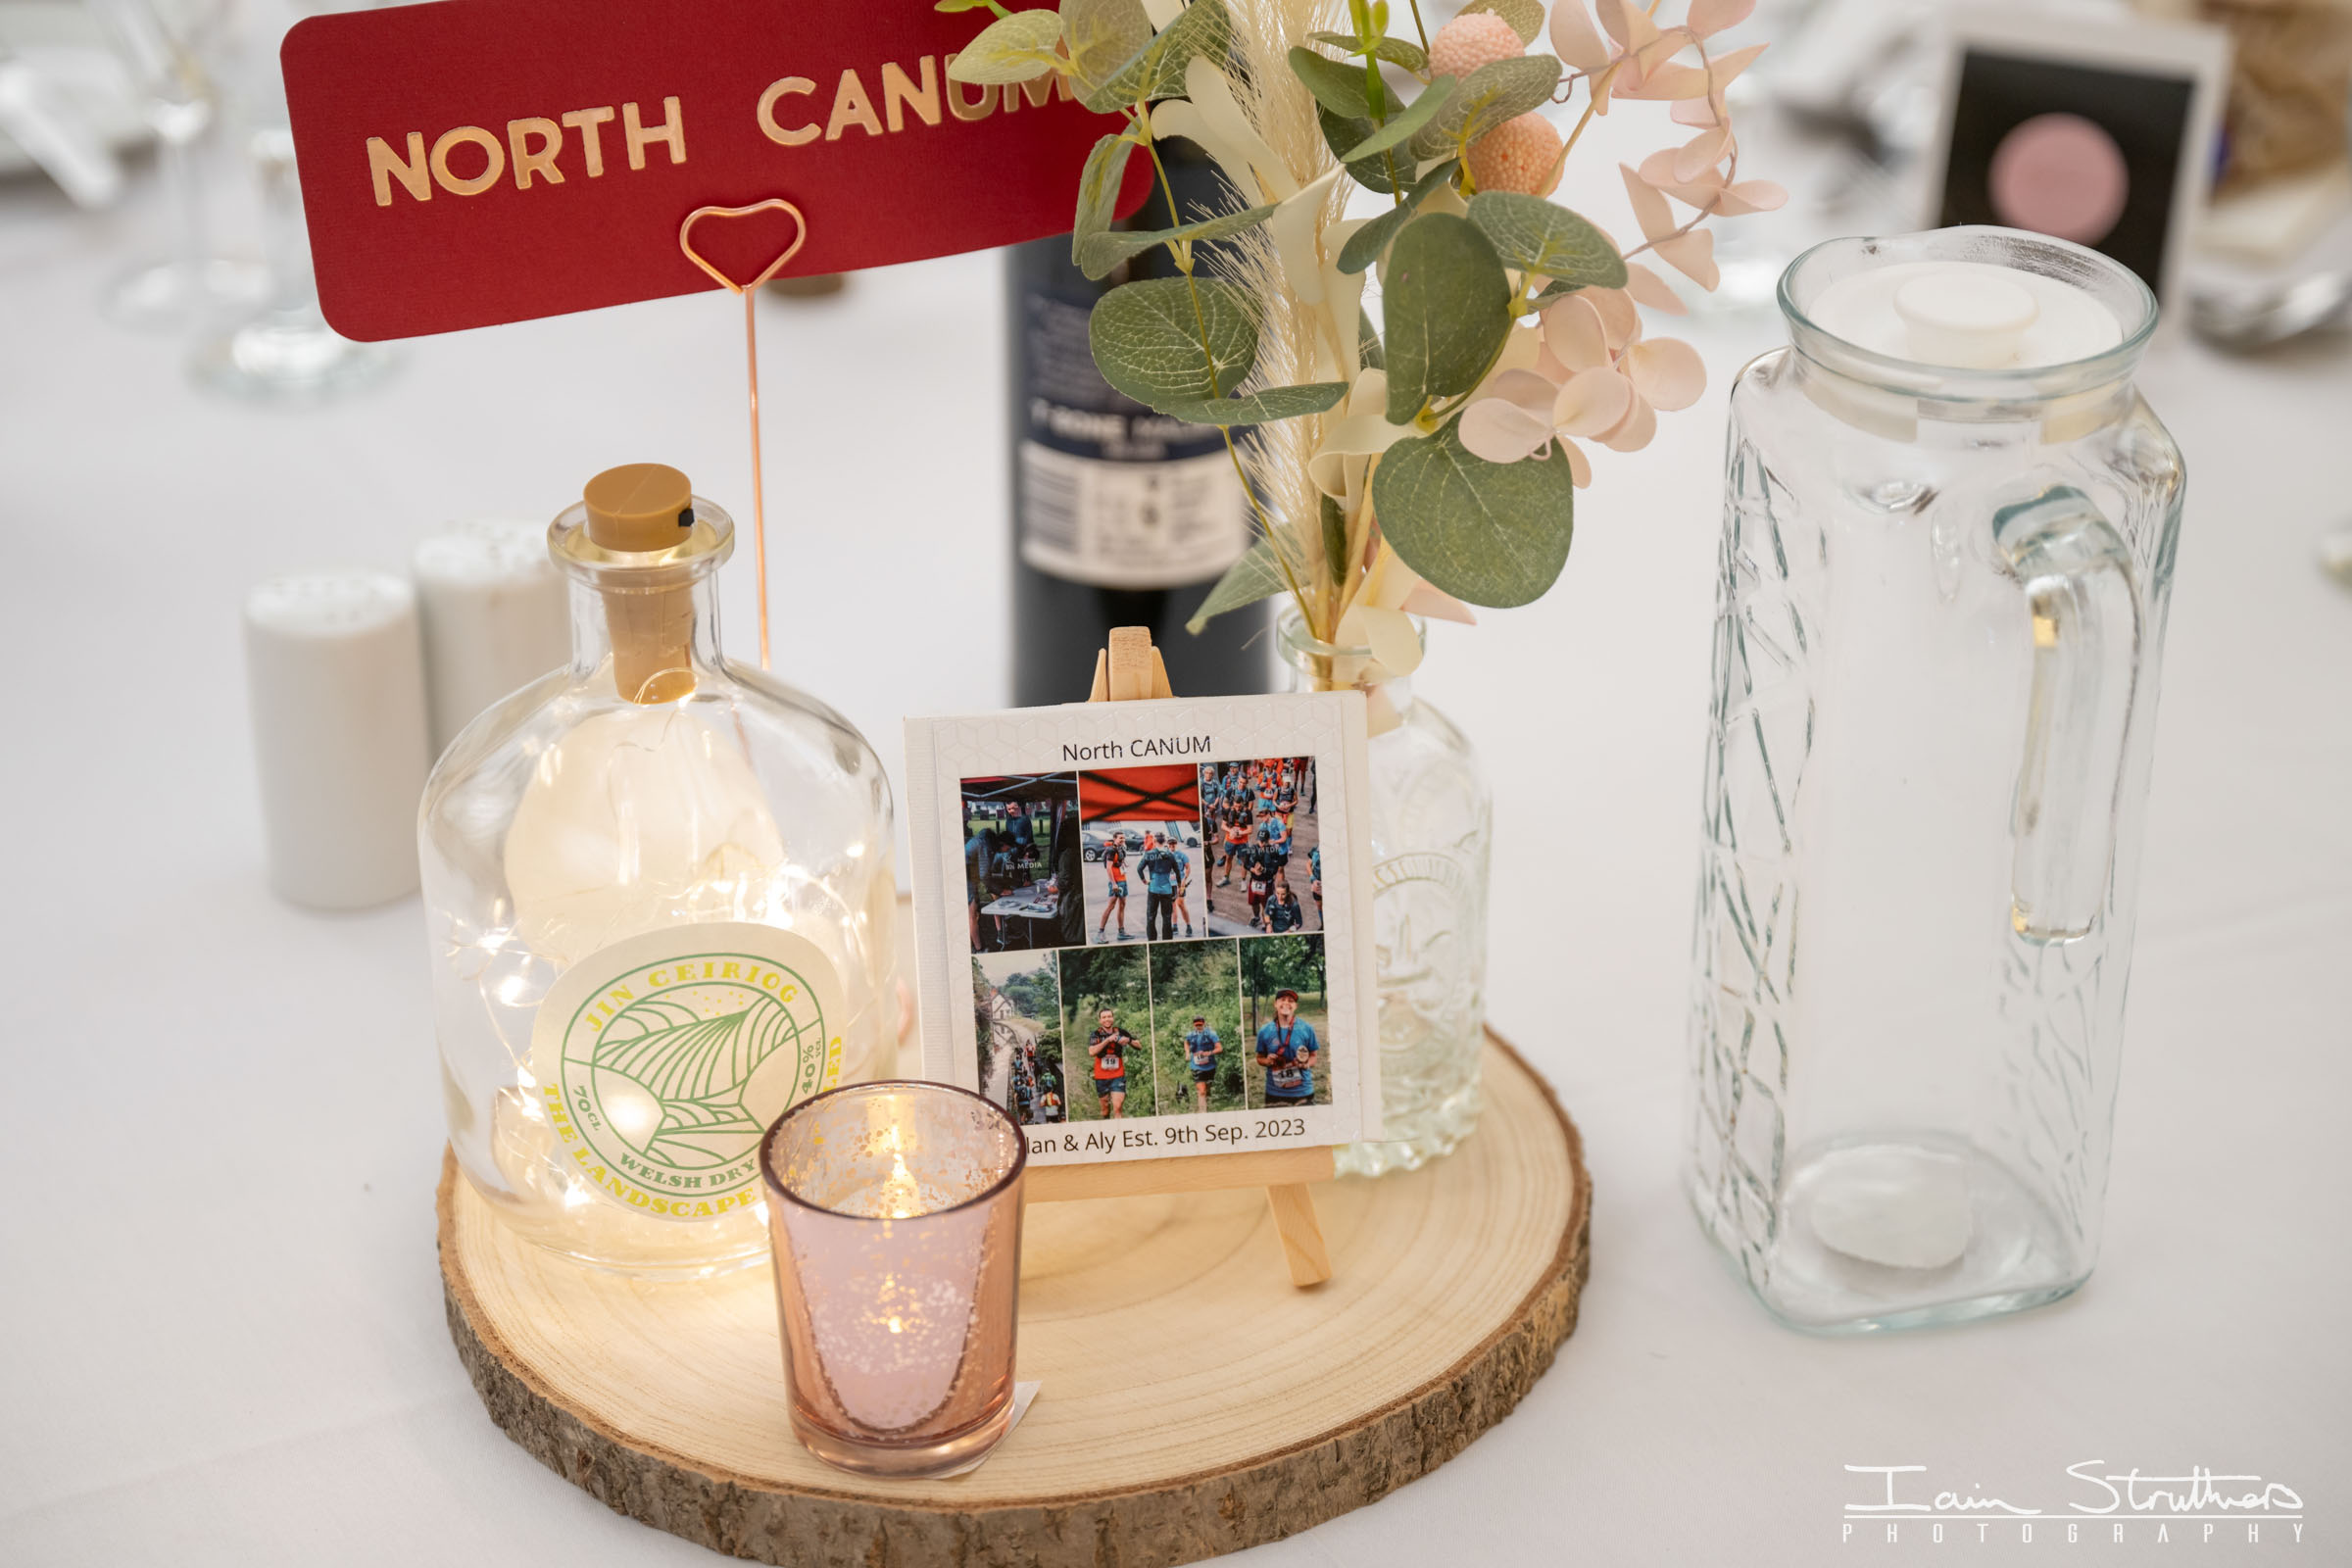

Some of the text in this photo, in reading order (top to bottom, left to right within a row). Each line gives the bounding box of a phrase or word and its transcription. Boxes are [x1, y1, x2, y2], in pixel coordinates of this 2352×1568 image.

[366, 96, 687, 208] NORTH
[1062, 735, 1211, 761] North CANUM
[585, 961, 799, 1032] JIN CEIRIOG
[802, 1045, 815, 1095] 40%
[543, 1083, 757, 1217] THE LANDSCAPE
[1063, 1134, 1079, 1152] &
[1085, 1131, 1116, 1154] Aly
[1122, 1129, 1158, 1148] Est.
[1164, 1125, 1199, 1145] 9th
[1204, 1124, 1249, 1144] Sep.
[1254, 1118, 1305, 1139] 2023
[620, 1152, 757, 1189] WELSH DRY
